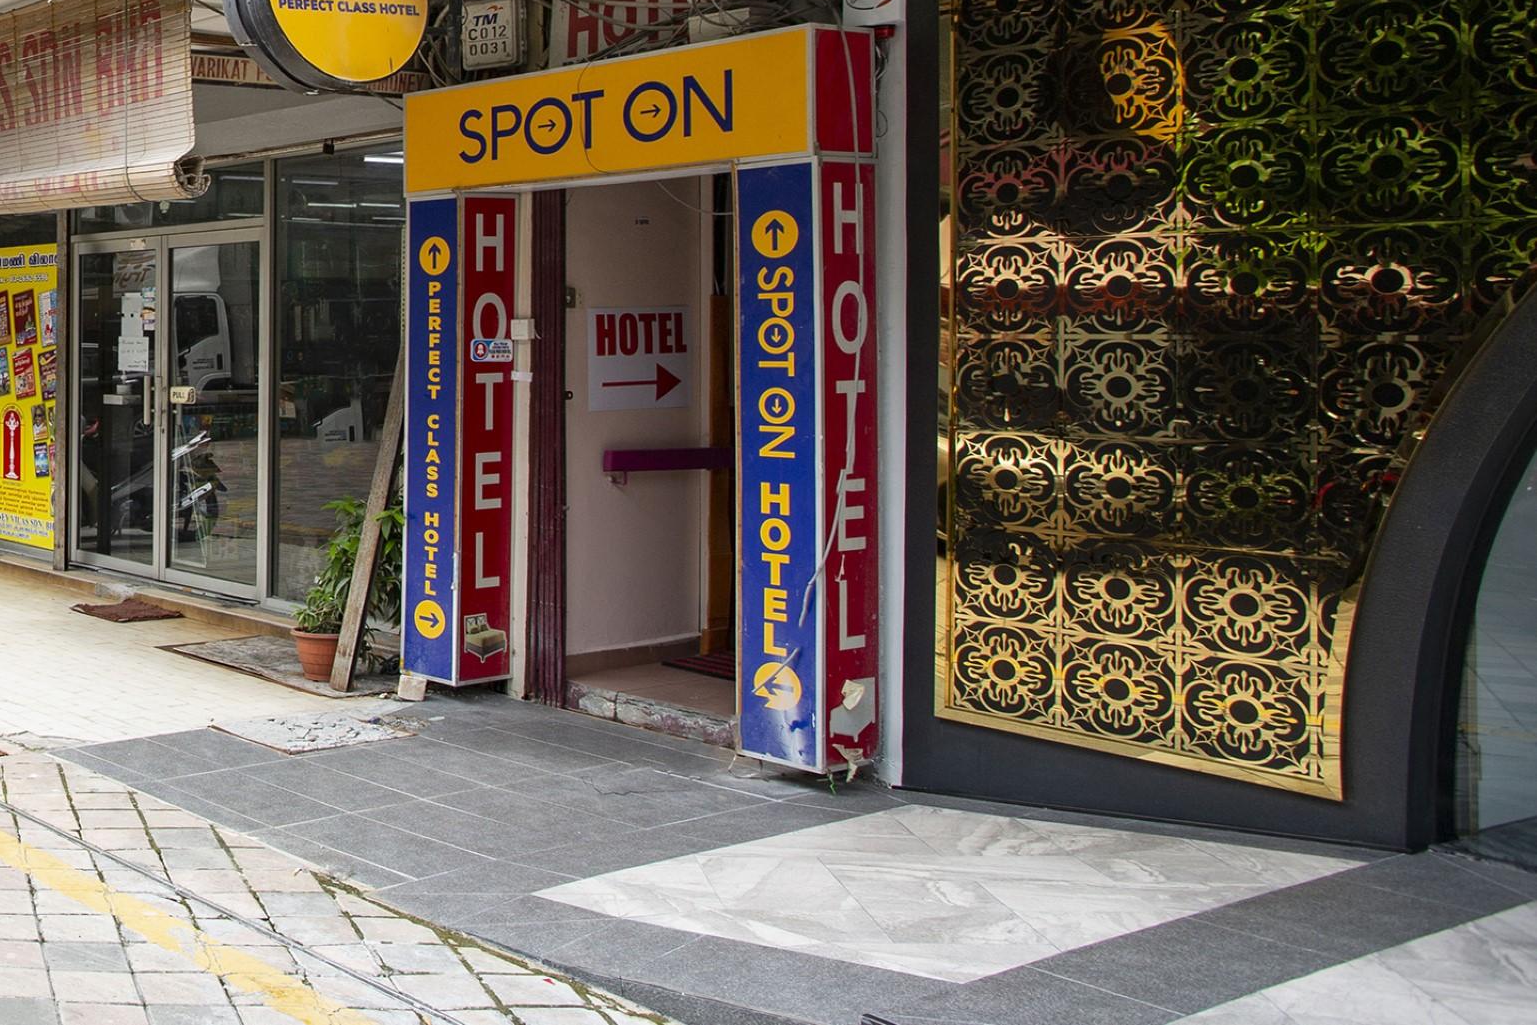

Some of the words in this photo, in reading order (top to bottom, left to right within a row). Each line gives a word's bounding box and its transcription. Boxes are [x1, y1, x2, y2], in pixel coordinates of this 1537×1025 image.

[337, 1, 377, 14] CLASS
[380, 3, 420, 16] HOTEL
[468, 26, 507, 41] C012
[469, 41, 508, 57] 0031
[472, 13, 498, 26] TM
[459, 89, 604, 163] SPOT
[623, 69, 733, 142] ON
[427, 282, 442, 400] PERFECT
[595, 313, 687, 356] HOTEL
[758, 266, 795, 377] SPOT
[473, 213, 507, 589] HOTEL
[758, 387, 795, 459] ON
[832, 182, 868, 651] HOTEL
[426, 414, 441, 498] CLASS
[424, 513, 438, 596] HOTEL
[760, 483, 791, 655] HOTEL
